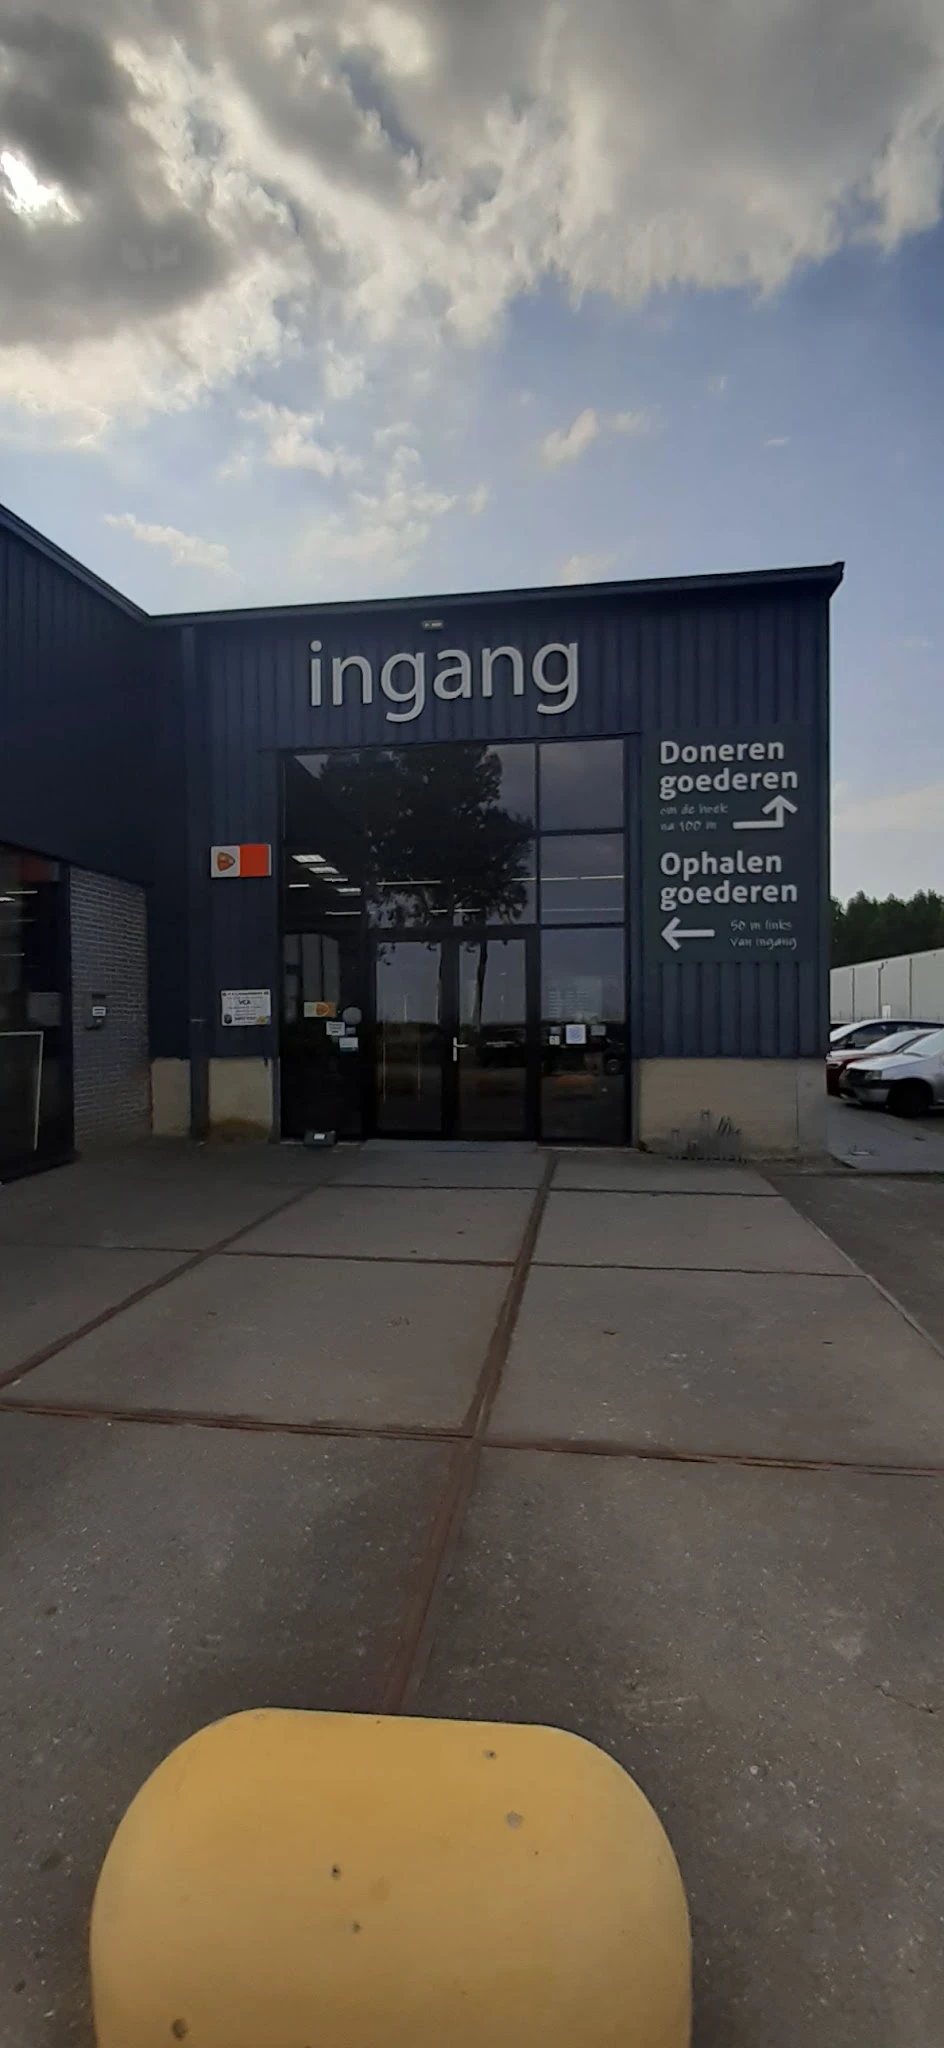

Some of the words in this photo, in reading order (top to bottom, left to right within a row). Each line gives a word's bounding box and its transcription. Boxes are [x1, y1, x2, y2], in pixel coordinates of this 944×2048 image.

[309, 640, 579, 722] ingang
[660, 740, 785, 765] Doneren
[659, 768, 798, 800] goederen
[681, 803, 695, 815] de
[679, 820, 702, 832] 100
[706, 821, 717, 830] m
[660, 850, 783, 881] Ophalen
[659, 880, 798, 912] goederen
[730, 919, 746, 932] 50
[750, 921, 761, 931] m
[765, 919, 793, 931] links
[730, 936, 752, 948] van
[755, 936, 798, 950] ingang
